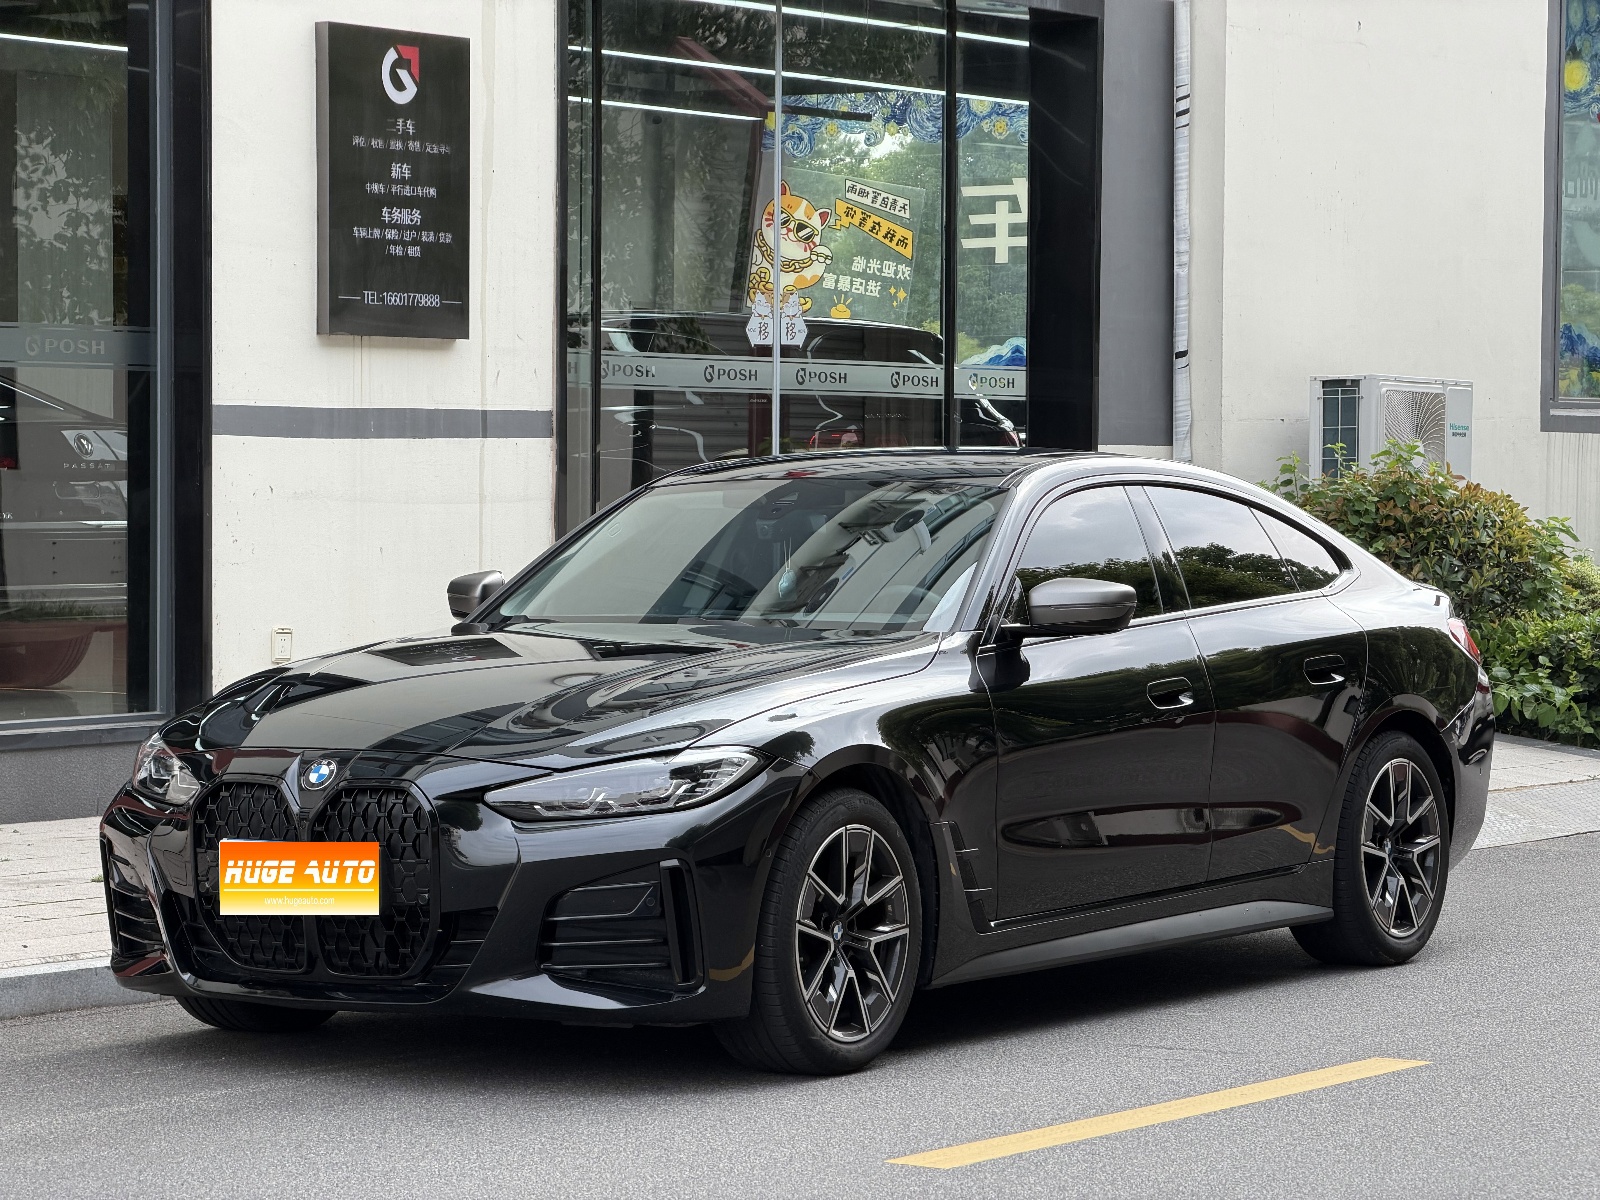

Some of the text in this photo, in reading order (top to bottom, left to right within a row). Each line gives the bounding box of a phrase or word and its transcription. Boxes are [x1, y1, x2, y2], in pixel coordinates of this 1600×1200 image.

[386, 118, 416, 136] 二手车
[390, 162, 412, 180] 新车
[381, 206, 422, 225] 车务服务
[758, 321, 769, 340] 移
[785, 322, 796, 341] 移
[45, 339, 105, 355] POSH
[612, 364, 656, 378] POSH
[717, 368, 758, 382] POSH
[808, 371, 848, 384] POSH
[902, 374, 939, 387] POSH
[980, 376, 1015, 389] POSH
